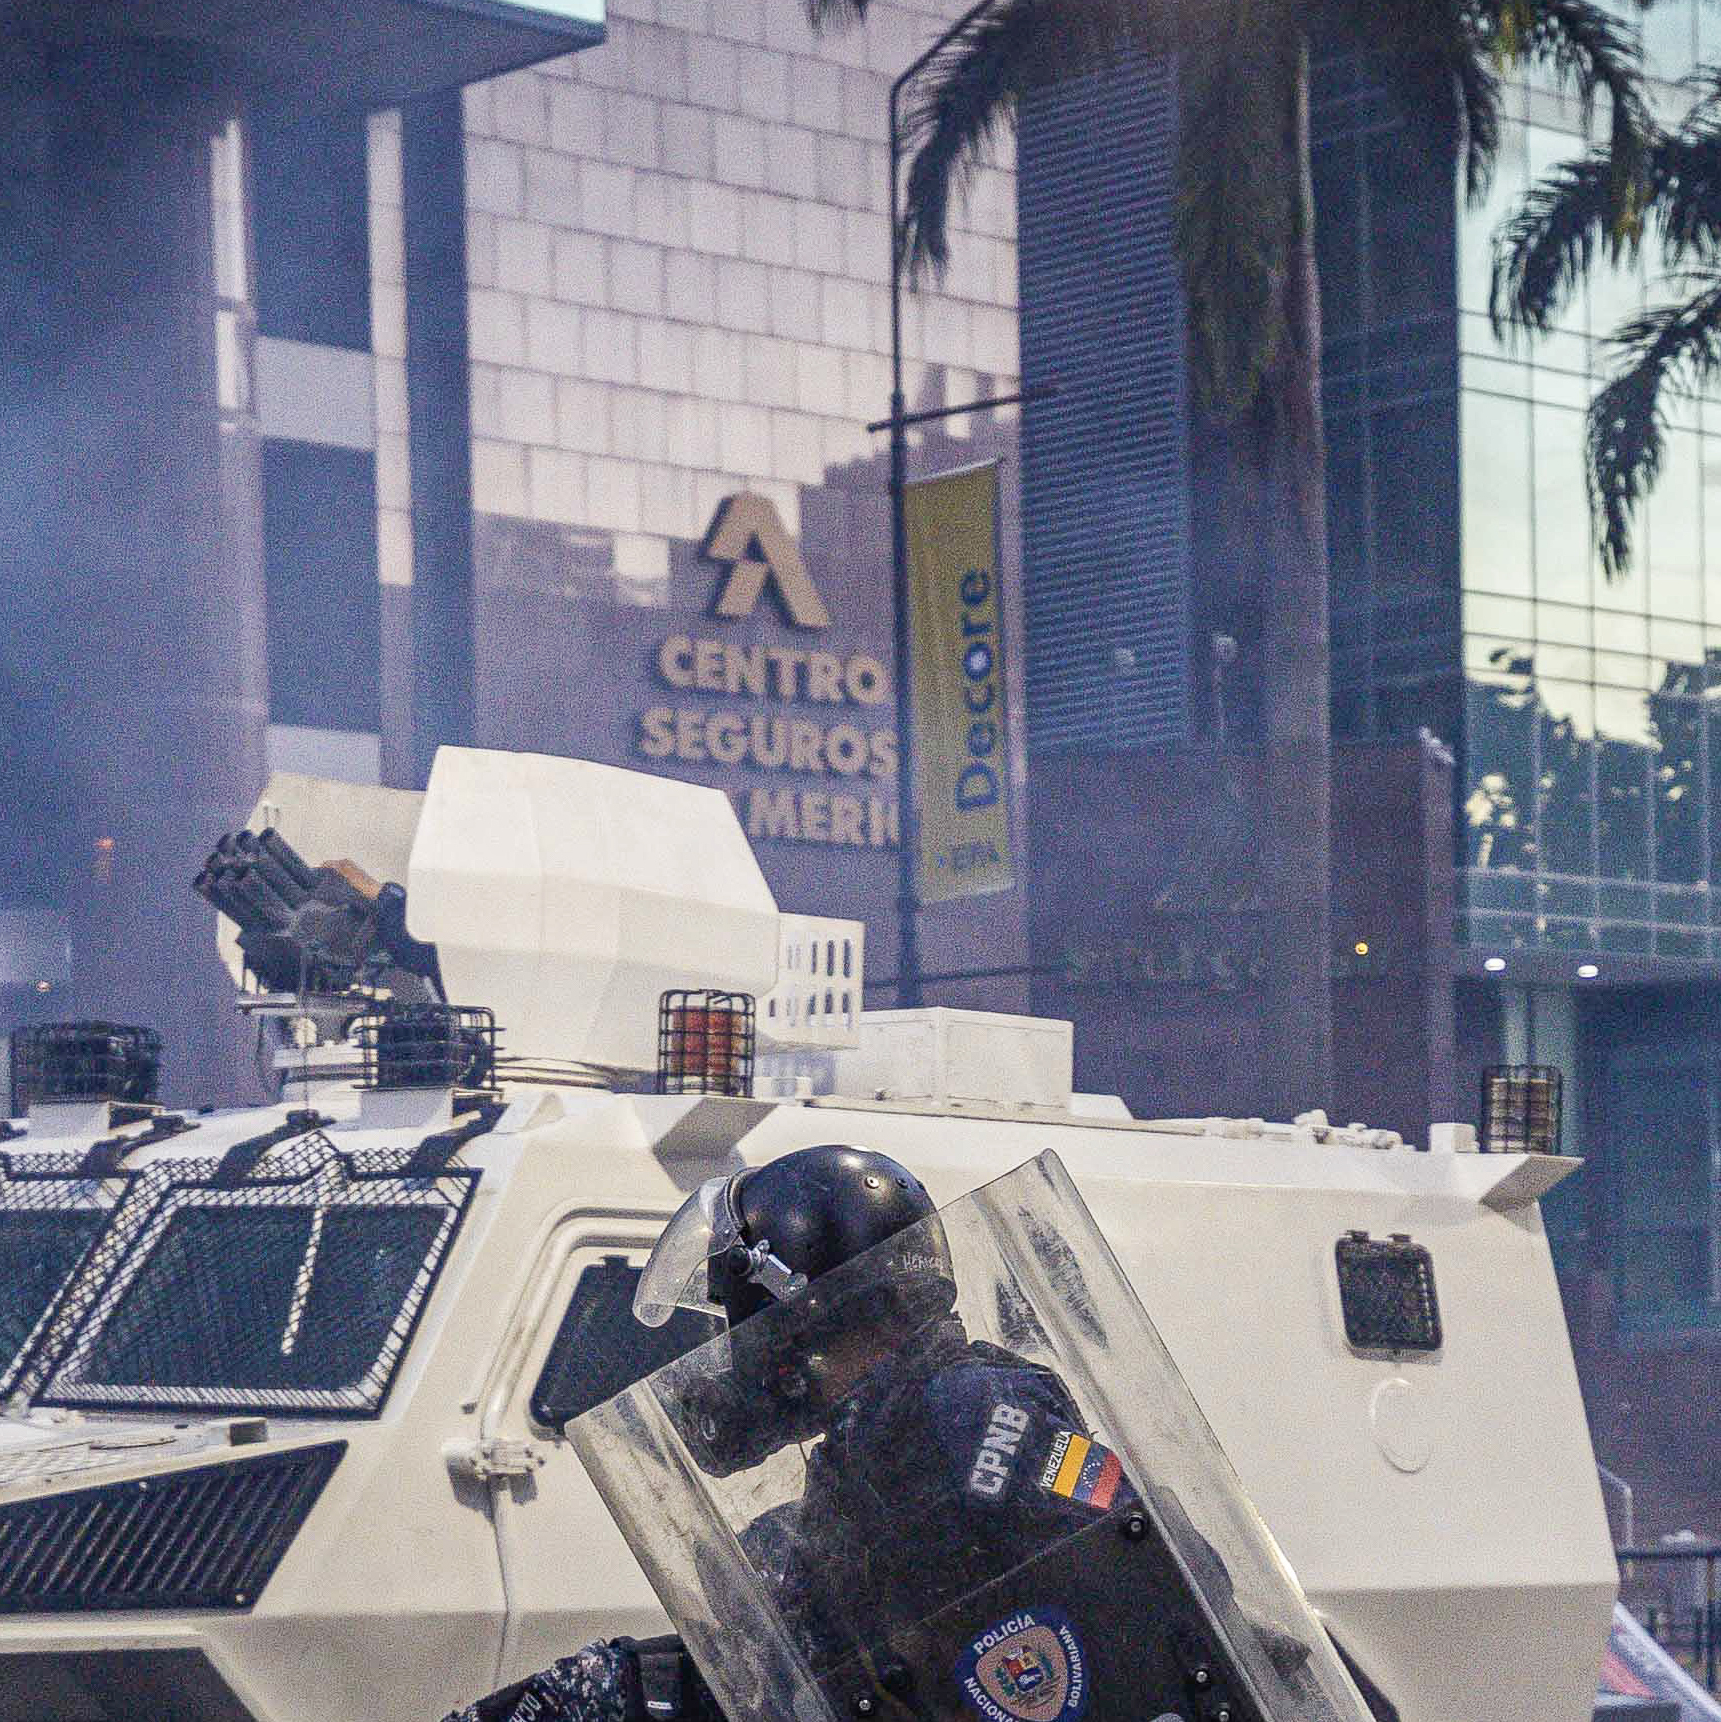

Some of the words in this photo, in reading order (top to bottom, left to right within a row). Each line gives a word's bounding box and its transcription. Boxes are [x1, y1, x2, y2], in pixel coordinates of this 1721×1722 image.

[659, 634, 889, 705] CENTRO
[955, 567, 1000, 813] Decore
[641, 706, 899, 776] SEGUROS
[970, 1403, 1029, 1494] CPNB
[1041, 1430, 1072, 1488] VENEZUELA
[1058, 1625, 1083, 1708] BOLIVARIANA
